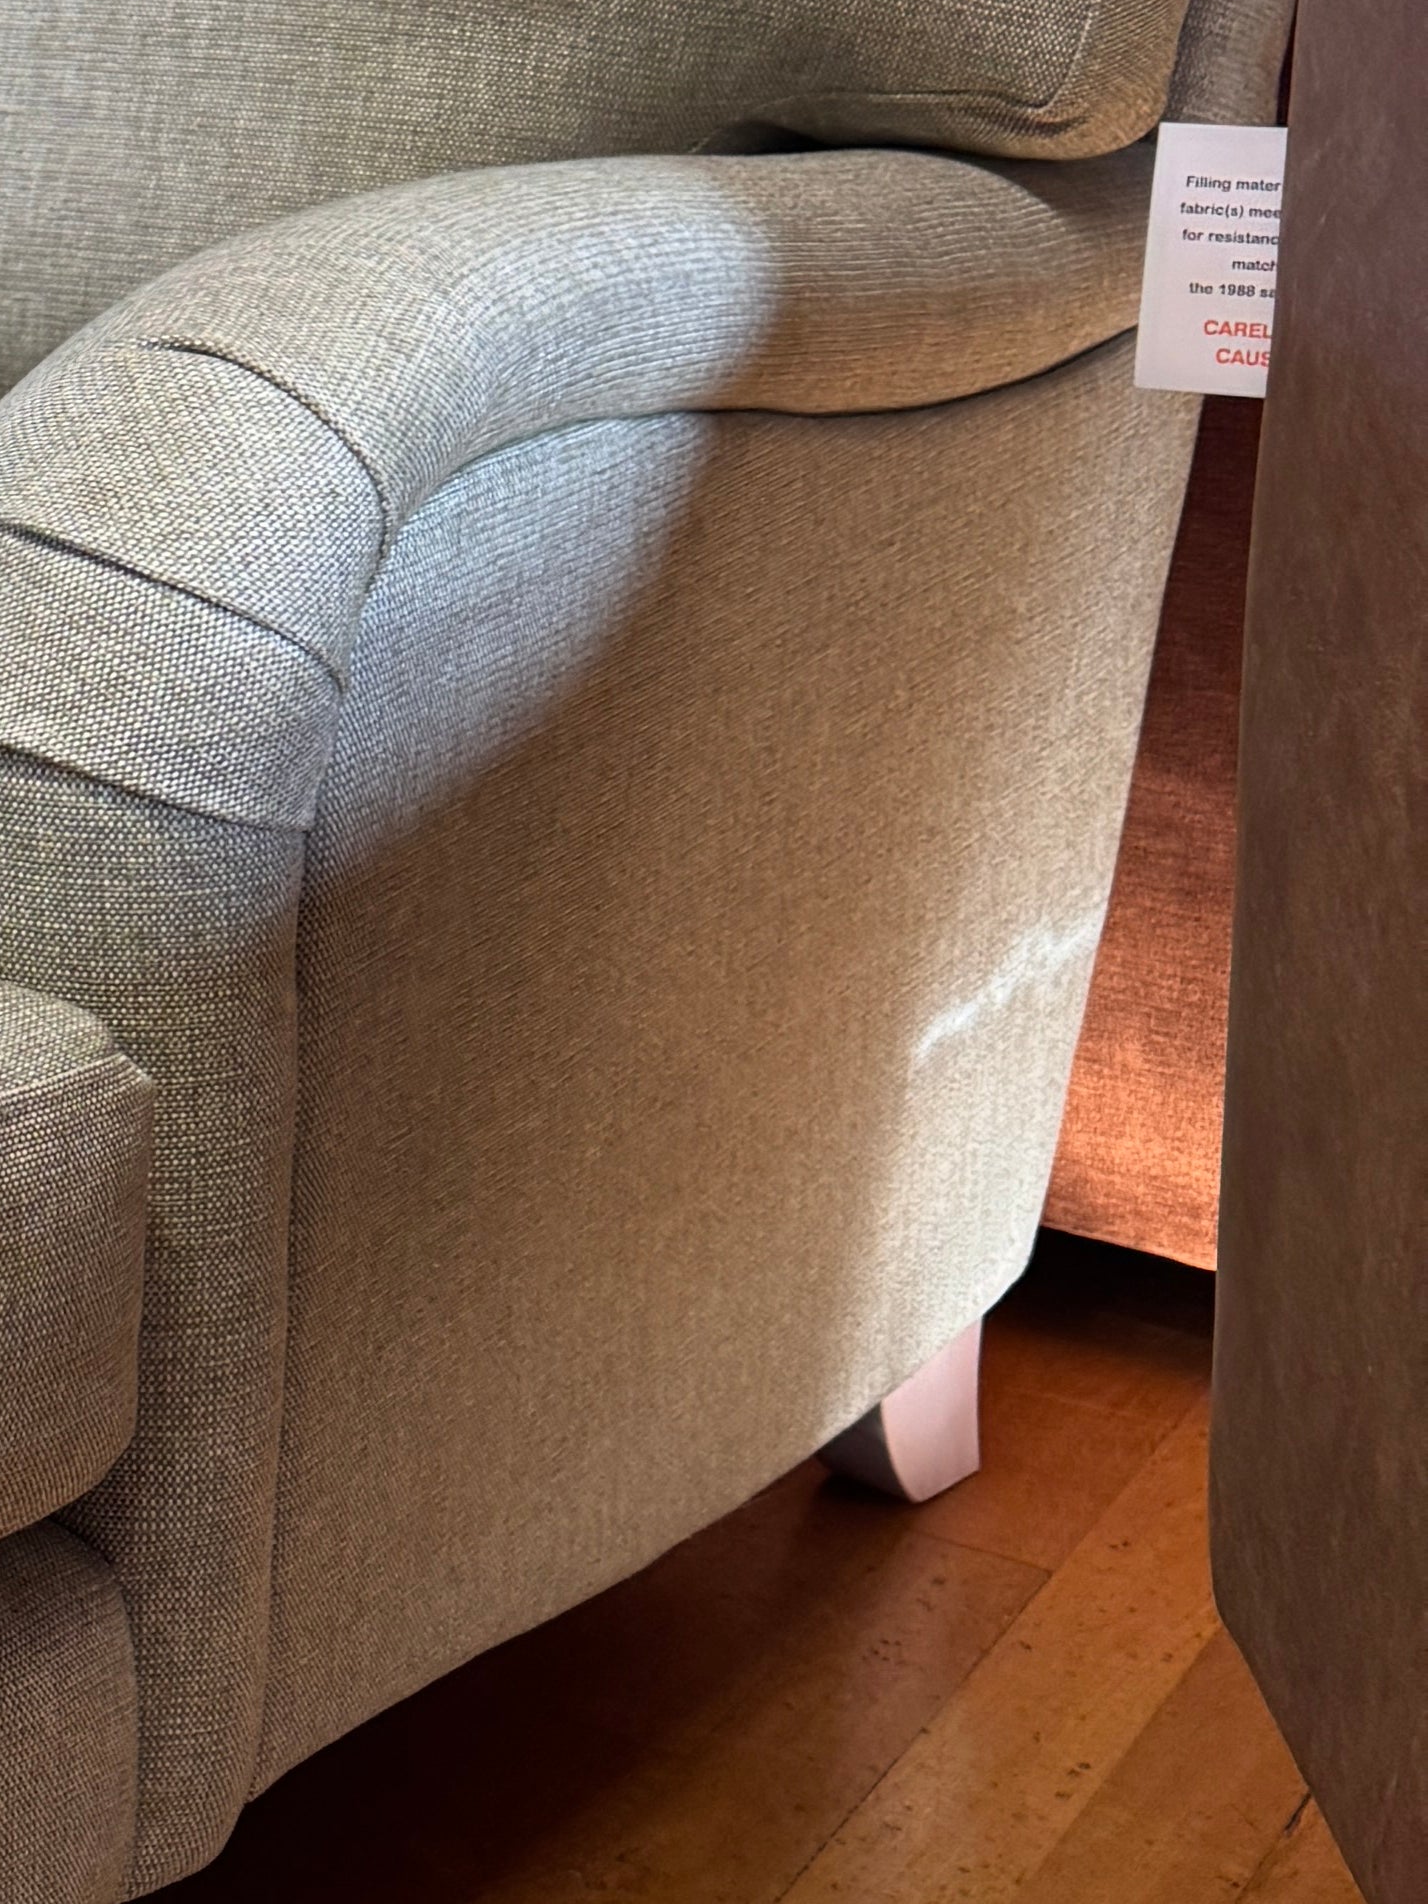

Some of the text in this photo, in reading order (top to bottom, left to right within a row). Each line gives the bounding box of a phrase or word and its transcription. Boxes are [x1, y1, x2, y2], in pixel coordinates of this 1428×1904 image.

[1186, 175, 1232, 192] Filling
[1180, 202, 1244, 219] fabric(s)
[1182, 229, 1204, 242] for
[1189, 282, 1214, 295] the
[1219, 283, 1256, 298] 1988
